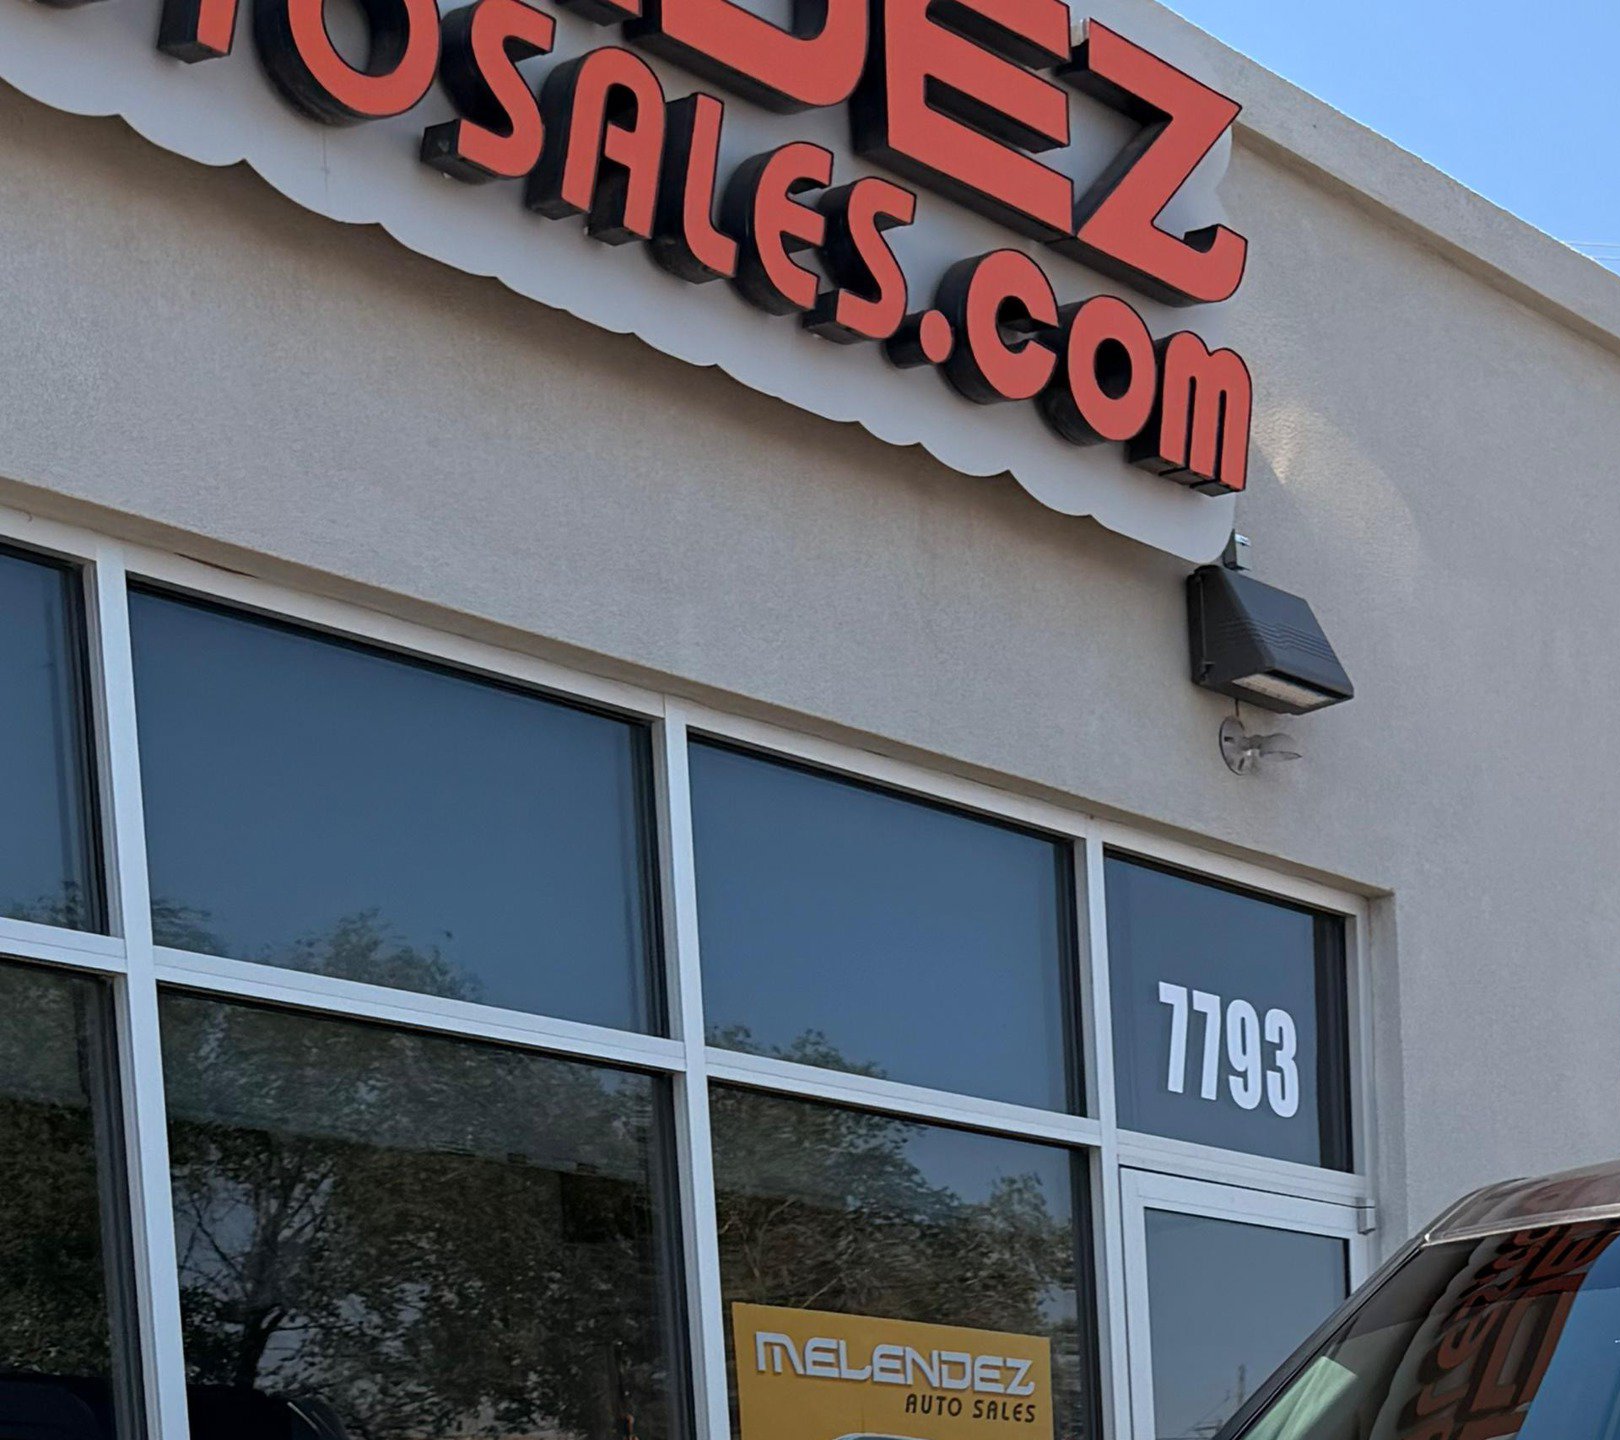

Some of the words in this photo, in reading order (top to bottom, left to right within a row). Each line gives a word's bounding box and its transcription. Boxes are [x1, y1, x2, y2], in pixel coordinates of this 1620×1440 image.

[1158, 981, 1300, 1118] 7793
[755, 1331, 1036, 1397] MELENDEZ
[905, 1393, 962, 1418] AUTO
[972, 1399, 1036, 1423] SALES
